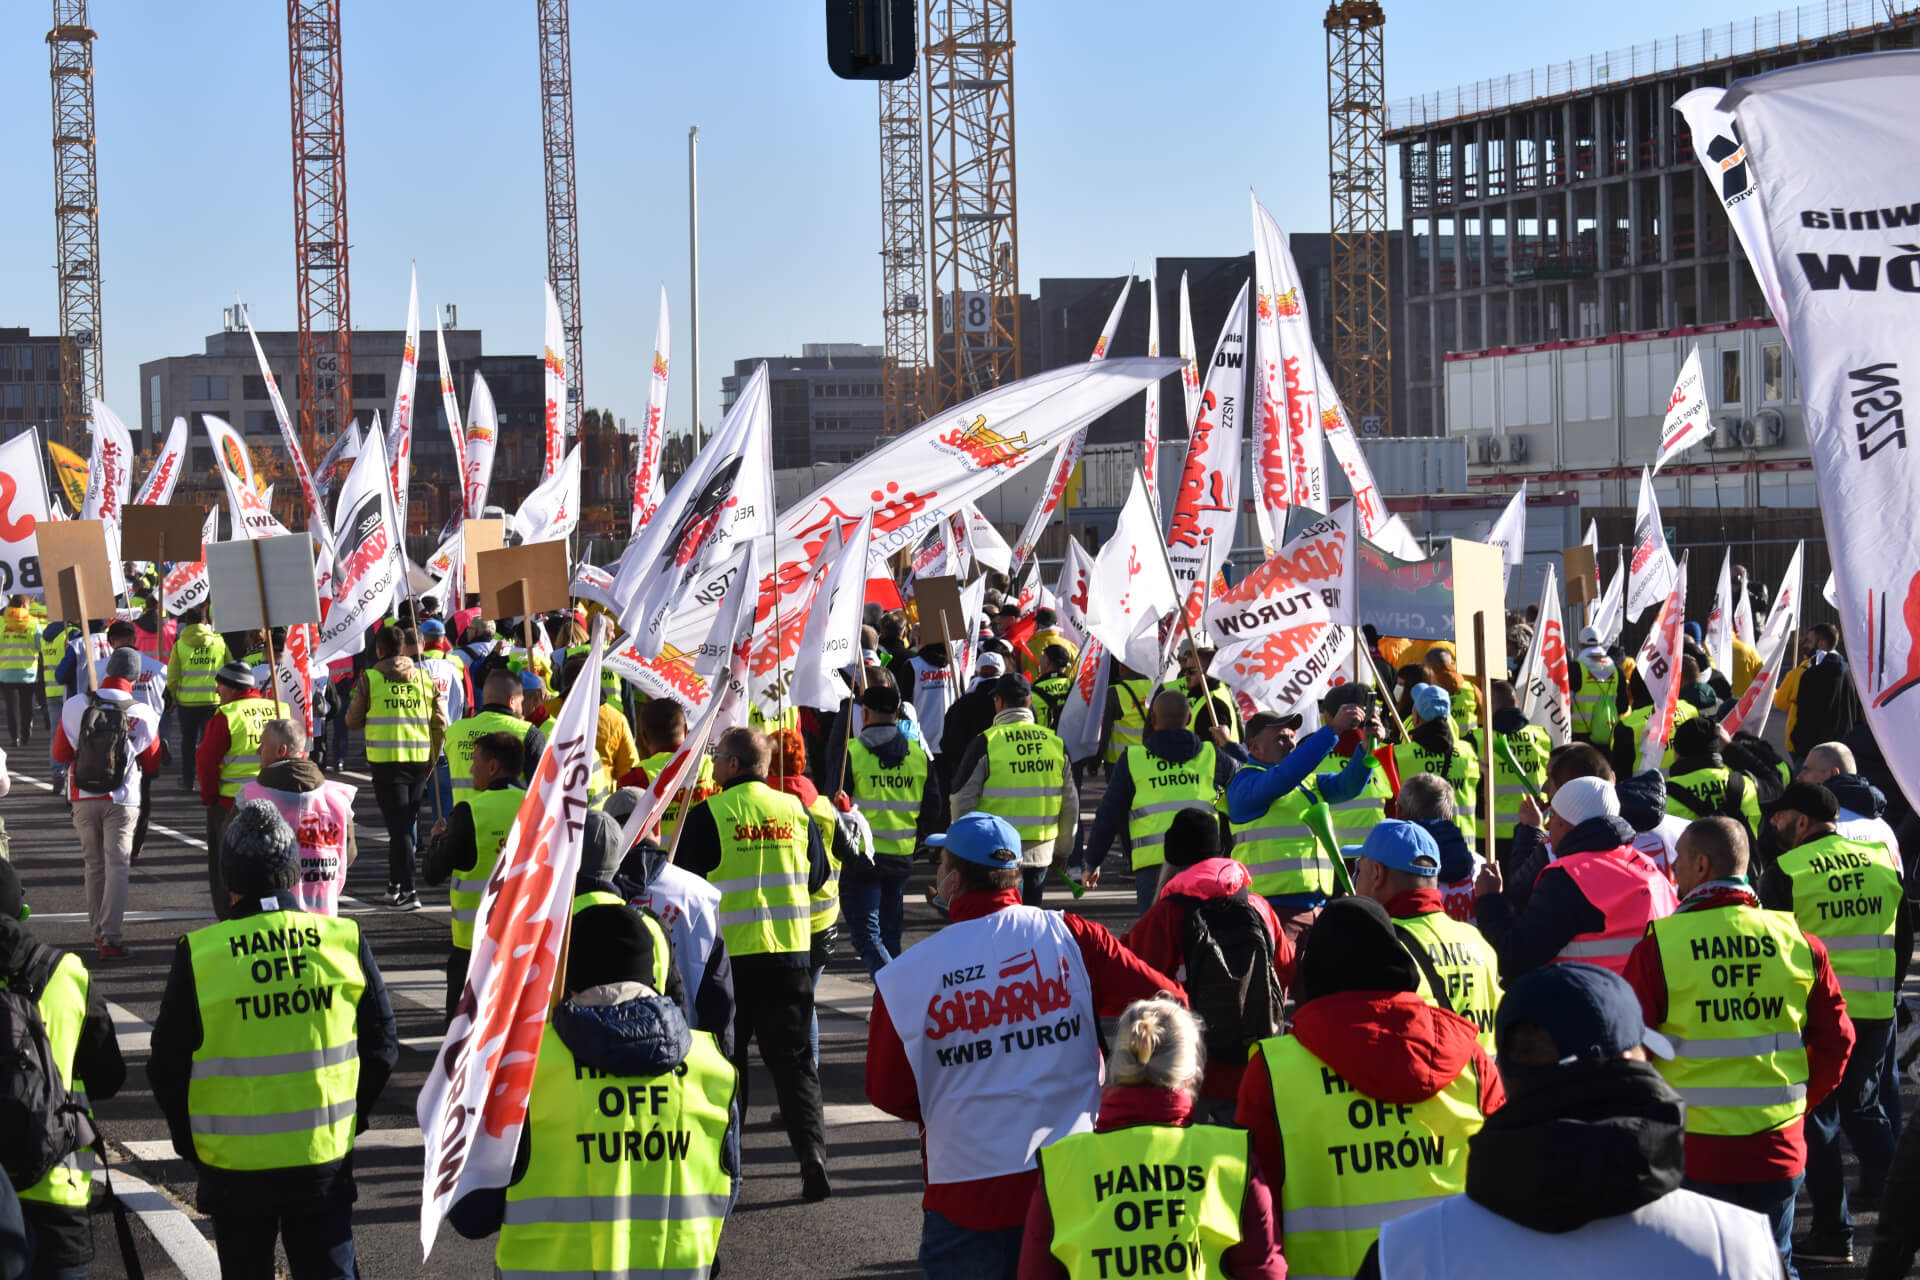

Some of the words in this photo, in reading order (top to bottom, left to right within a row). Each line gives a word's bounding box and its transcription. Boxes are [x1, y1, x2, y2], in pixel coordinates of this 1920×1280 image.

[968, 297, 986, 327] 8
[317, 356, 337, 371] G6
[1222, 396, 1235, 429] NSZZ
[1362, 420, 1380, 434] G5
[384, 696, 421, 709] TURÓW
[391, 685, 413, 695] OFF
[1004, 730, 1048, 743] HANDS
[1016, 743, 1043, 756] OFF
[1009, 756, 1055, 774] TURÓW
[870, 772, 914, 789] TURÓW
[1149, 772, 1201, 790] TURÓW
[1810, 852, 1872, 874] HANDS
[1828, 873, 1865, 893] OFF
[1816, 895, 1883, 921] TURÓW
[229, 928, 322, 958] HANDS
[1690, 934, 1777, 962] HANDS
[251, 955, 308, 984] OFF
[942, 964, 987, 989] NSZZ
[1711, 964, 1762, 988] OFF
[235, 984, 334, 1021] TURÓW
[1695, 991, 1785, 1023] TURÓW
[937, 1039, 994, 1068] KWB
[999, 1013, 1082, 1054] TURÓW
[598, 1086, 669, 1118] OFF
[1348, 1099, 1413, 1130] OFF
[576, 1127, 691, 1165] TURÓW
[1328, 1130, 1445, 1177] TURÓW
[1093, 1164, 1206, 1202] HANDS
[1114, 1199, 1186, 1232] OFF
[1092, 1233, 1205, 1280] TURÓW
